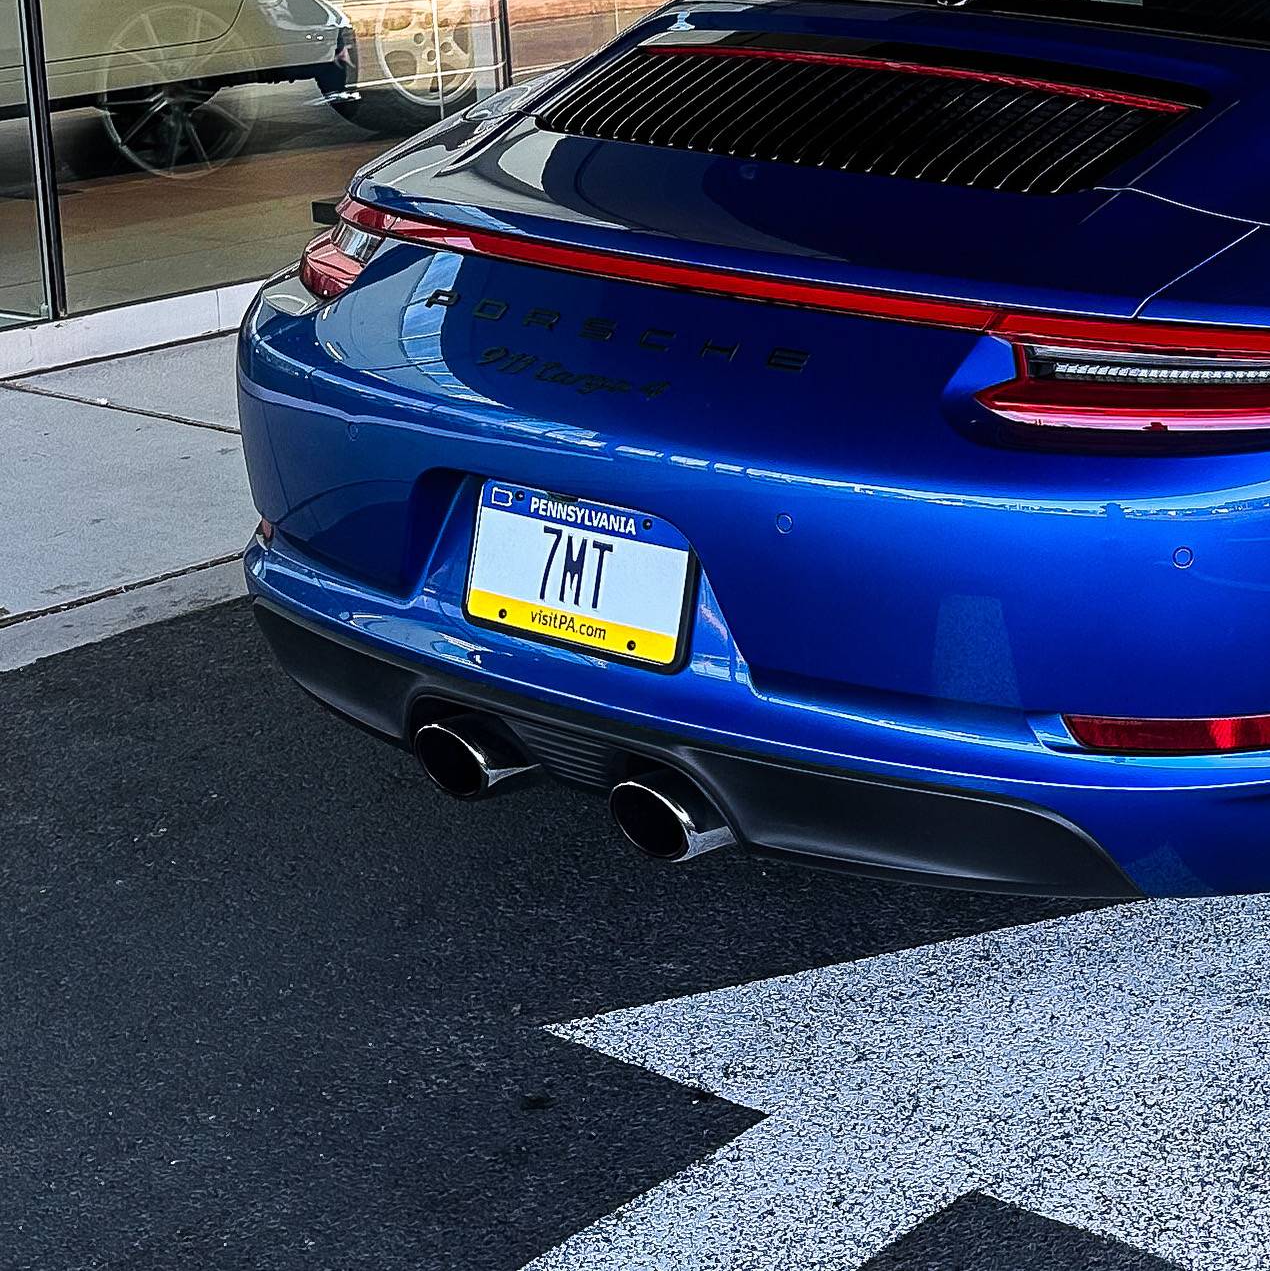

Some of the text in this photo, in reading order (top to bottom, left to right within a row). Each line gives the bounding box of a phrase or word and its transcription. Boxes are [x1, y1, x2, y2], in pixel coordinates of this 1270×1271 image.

[425, 288, 811, 372] PORSCHE
[477, 346, 536, 375] 911
[534, 361, 632, 394] targa
[530, 496, 637, 536] PENNSYLVANIA
[539, 525, 614, 609] 7MT
[530, 610, 608, 641] visitPA.com
